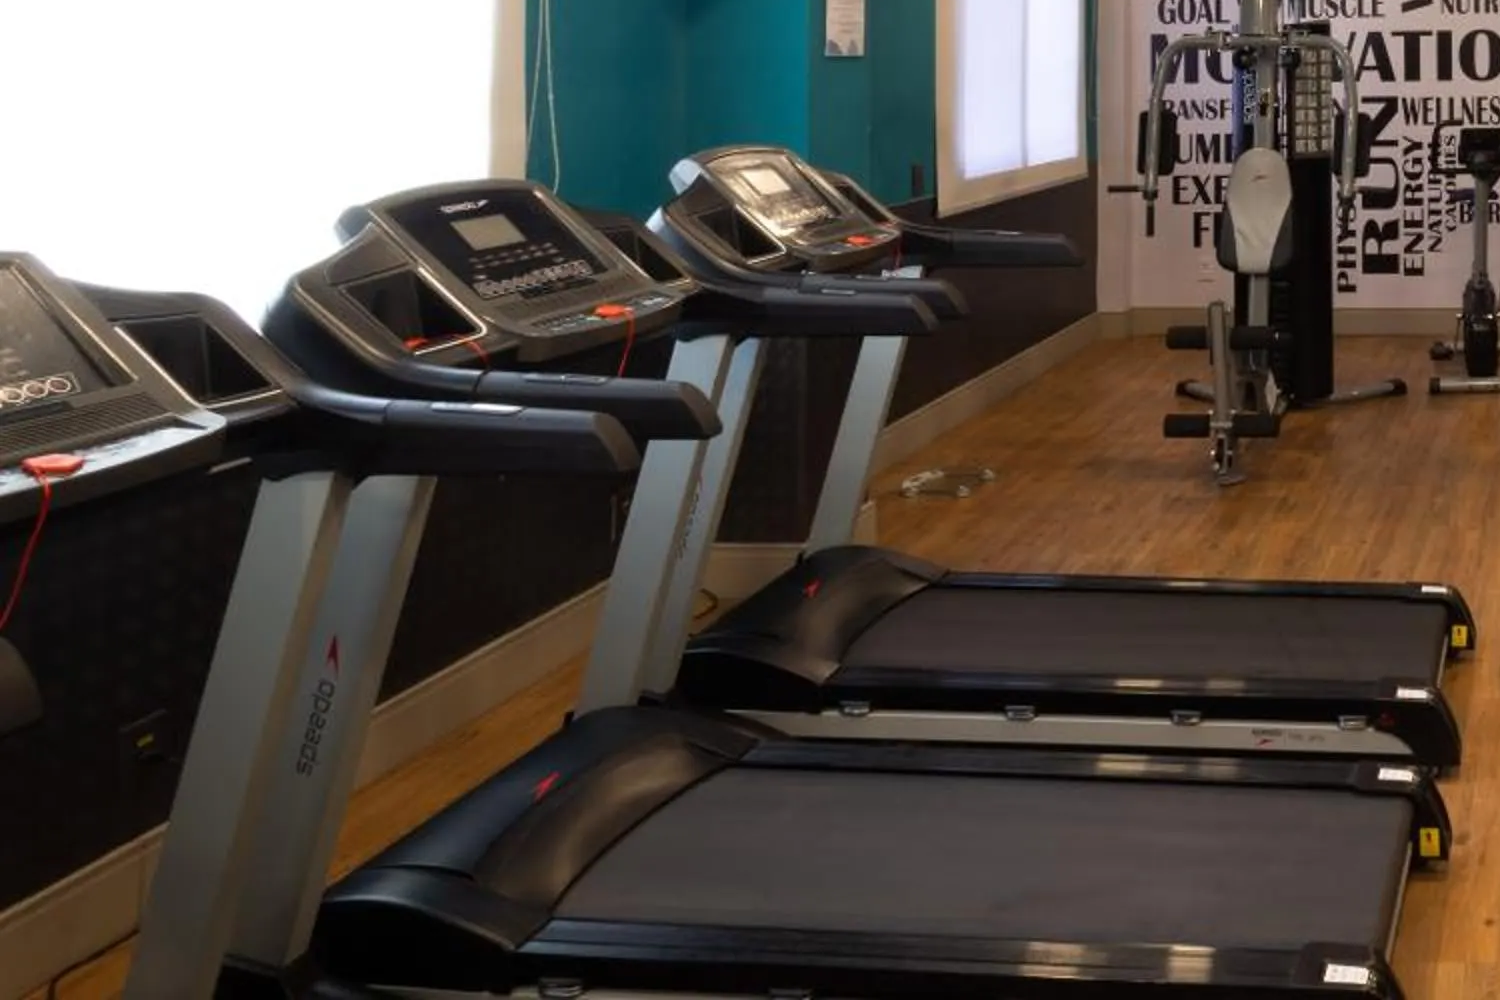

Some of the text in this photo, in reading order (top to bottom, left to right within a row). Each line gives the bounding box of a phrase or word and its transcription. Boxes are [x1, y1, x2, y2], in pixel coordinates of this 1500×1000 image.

[1361, 96, 1399, 274] RUN
[1403, 136, 1424, 276] ENERGY
[296, 678, 335, 777] speedo
